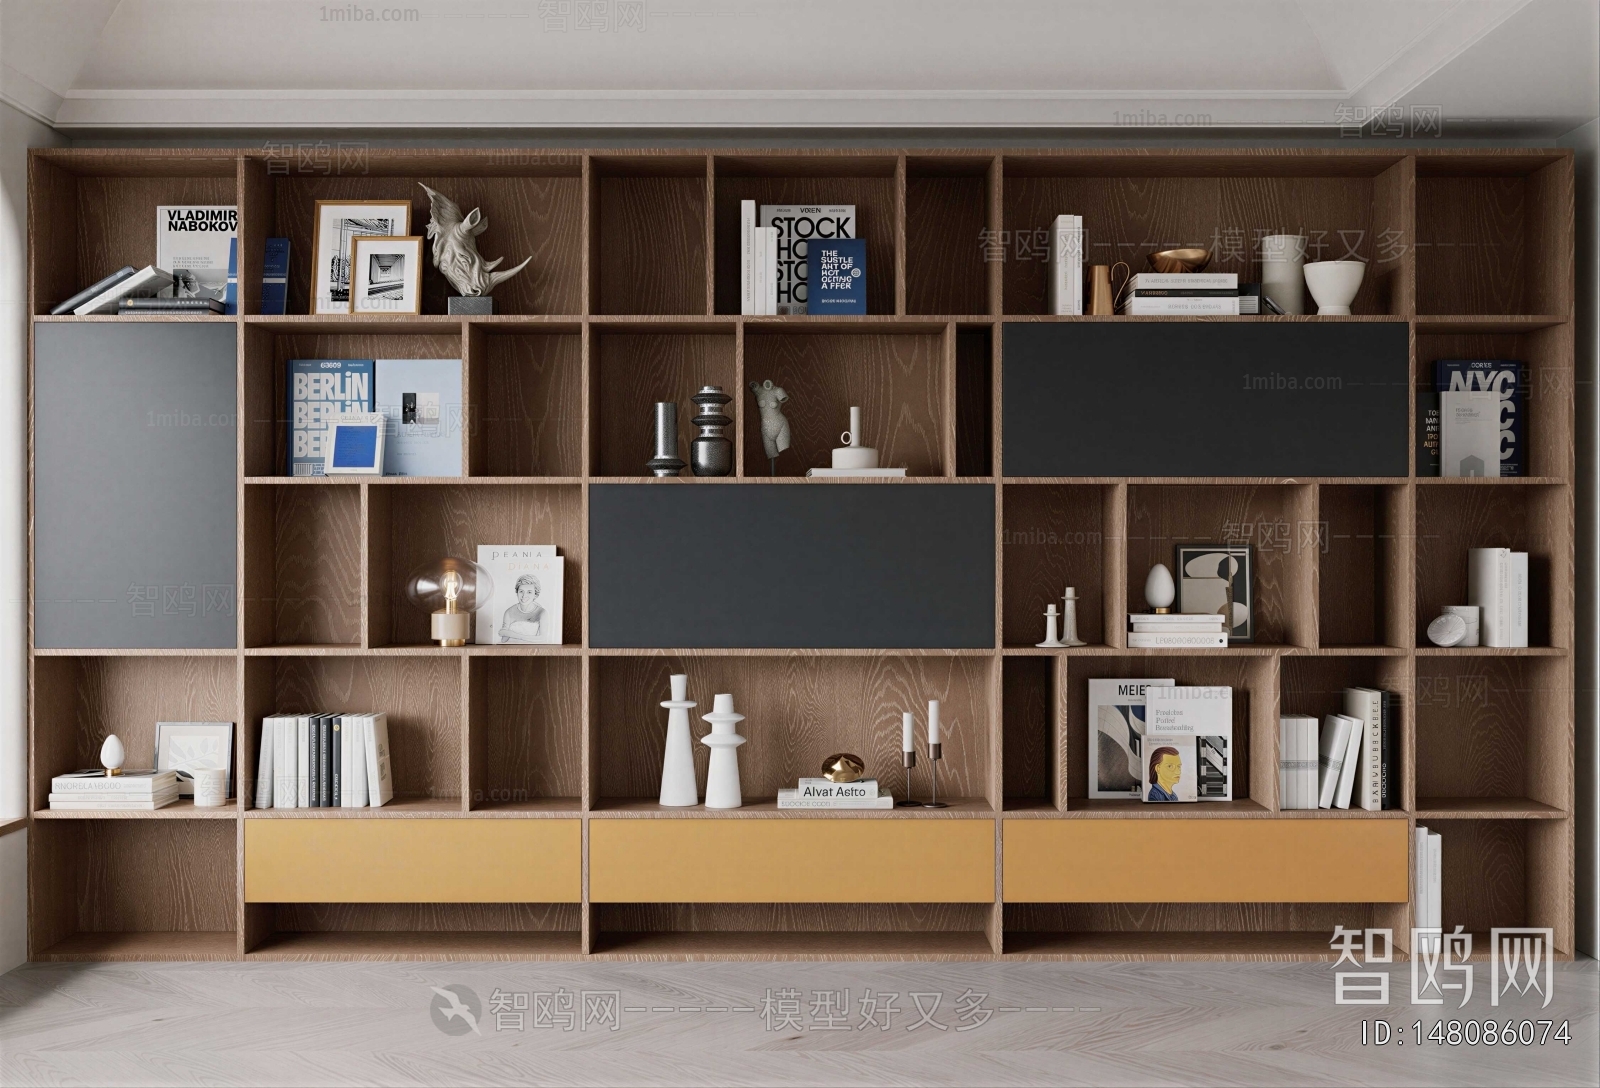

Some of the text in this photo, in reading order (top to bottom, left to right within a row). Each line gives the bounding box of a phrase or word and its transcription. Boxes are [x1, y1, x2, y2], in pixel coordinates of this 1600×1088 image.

[168, 210, 238, 221] VLADIMIR
[168, 221, 238, 232] NABOKOV
[771, 216, 851, 239] STOCK
[1449, 370, 1516, 400] NYC
[1118, 684, 1151, 696] MEIE
